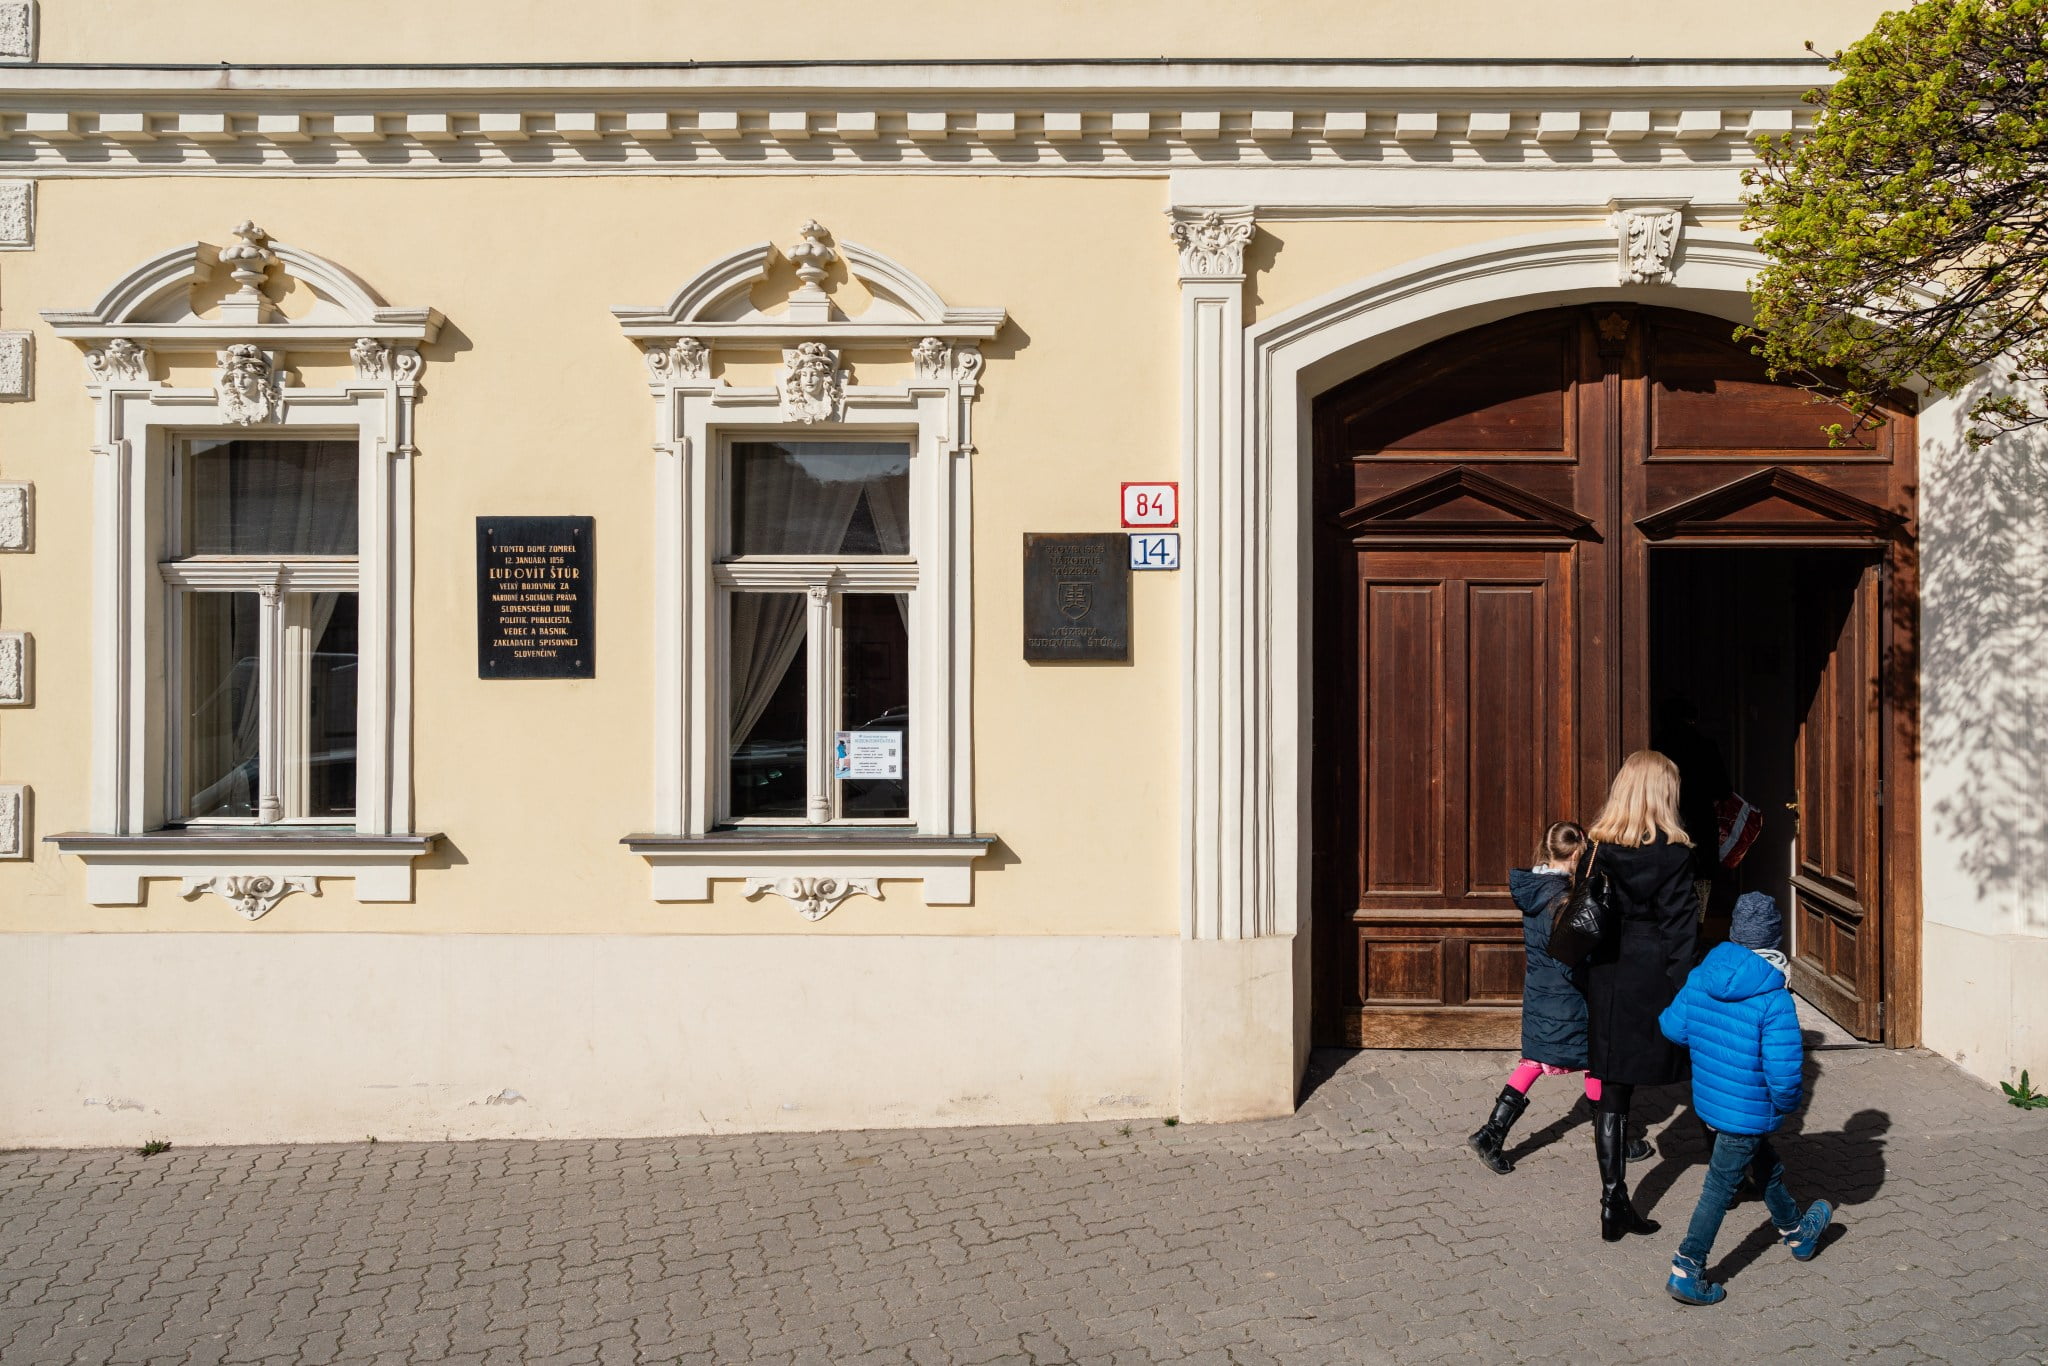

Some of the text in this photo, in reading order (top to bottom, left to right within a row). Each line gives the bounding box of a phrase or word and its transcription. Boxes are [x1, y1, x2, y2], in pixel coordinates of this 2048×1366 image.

[1137, 493, 1163, 516] 84
[499, 545, 524, 553] TOMTO
[527, 545, 546, 553] DOME
[549, 545, 576, 553] ZOMREL
[1138, 538, 1170, 565] 14
[505, 556, 513, 564] 12.
[549, 556, 564, 564] 1856
[489, 566, 580, 579] ĽUDOVÍT ŠTÚR
[521, 581, 556, 590] BOJOVNÍK
[560, 582, 569, 590] ZA
[520, 593, 524, 601] A
[556, 592, 577, 601] PRÁVA
[501, 604, 551, 613] SLOVENSKÉHO
[504, 627, 527, 635] VEDEC
[531, 627, 536, 635] A
[539, 639, 578, 647] SPISOVNEJ
